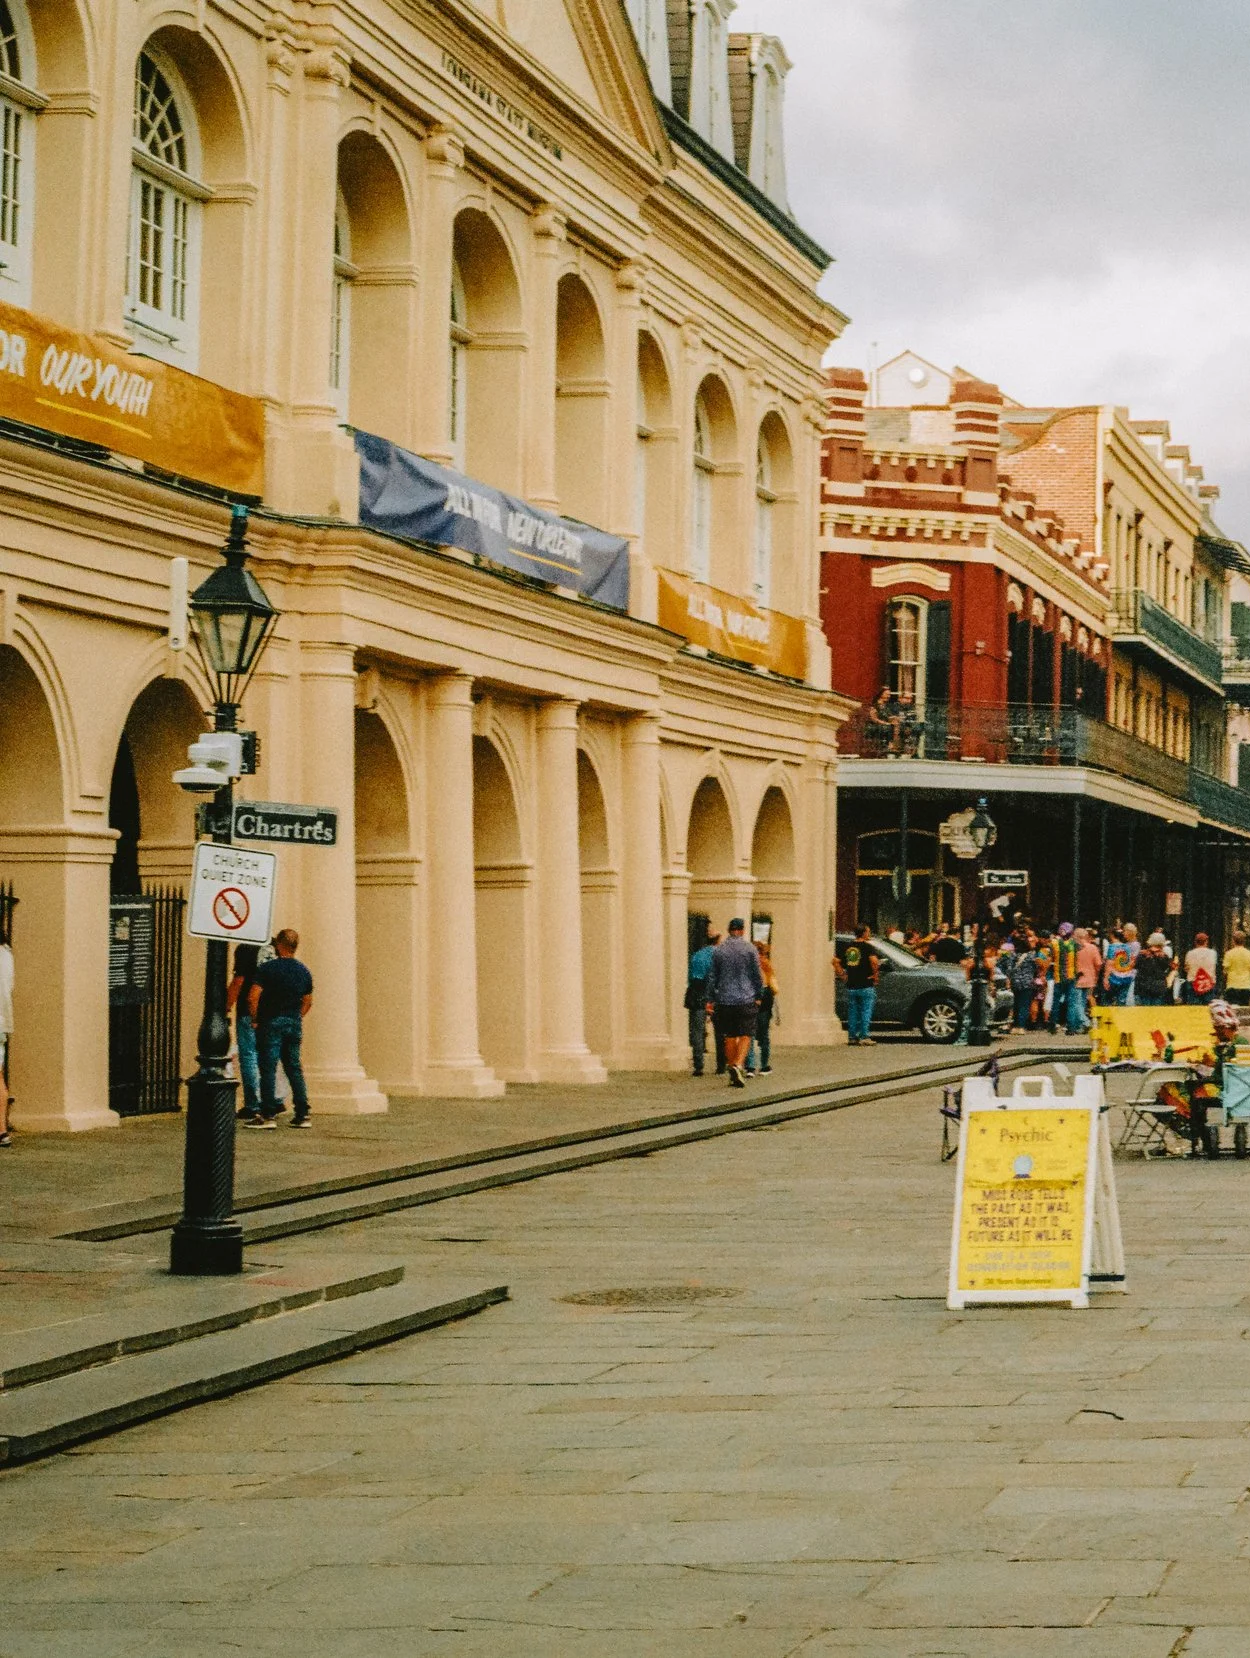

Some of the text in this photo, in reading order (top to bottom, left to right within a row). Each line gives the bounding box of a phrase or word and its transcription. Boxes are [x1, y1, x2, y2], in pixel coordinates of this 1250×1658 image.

[40, 343, 93, 398] OUR
[89, 358, 153, 418] YOUTH
[213, 854, 260, 871] CHURCH
[201, 868, 268, 889] QUIET ZONE
[999, 1126, 1054, 1144] Psychic
[971, 1202, 988, 1215] THE
